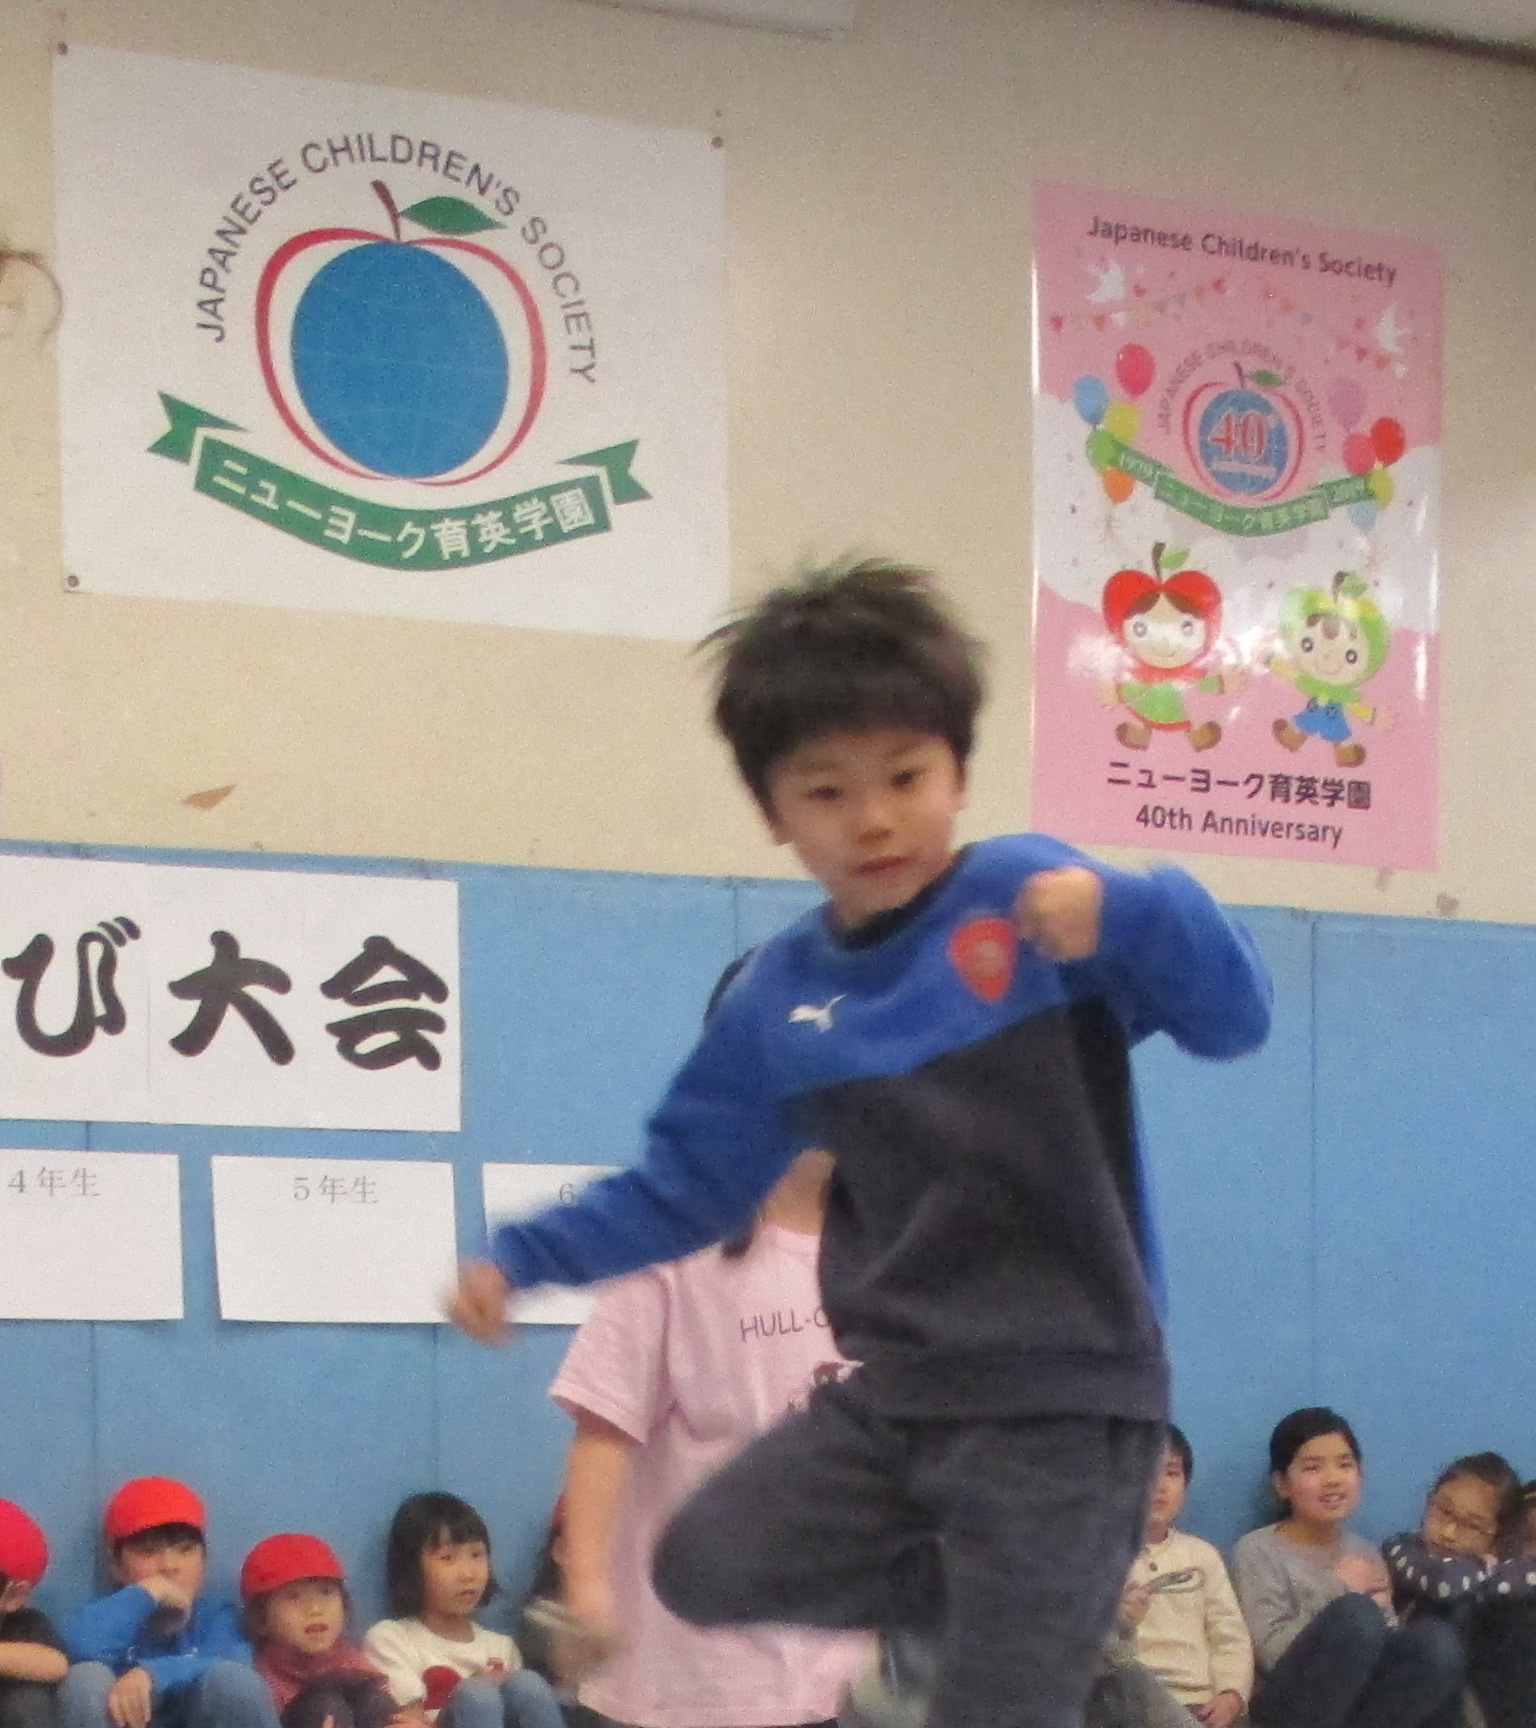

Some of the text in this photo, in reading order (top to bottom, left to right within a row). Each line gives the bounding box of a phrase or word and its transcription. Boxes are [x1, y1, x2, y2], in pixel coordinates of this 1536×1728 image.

[197, 133, 596, 384] JAPANESE CHILDREN'S SOCIETY
[1087, 213, 1397, 288] Japanese Children's Society
[211, 458, 597, 562] ニューヨーク育英学園
[1107, 761, 1371, 810] ニューヨーク育英学園
[1136, 804, 1344, 849] 40th Anniversary
[1, 916, 449, 1071] び大会
[7, 1165, 101, 1198] 4年生
[293, 1174, 378, 1205] 5年生
